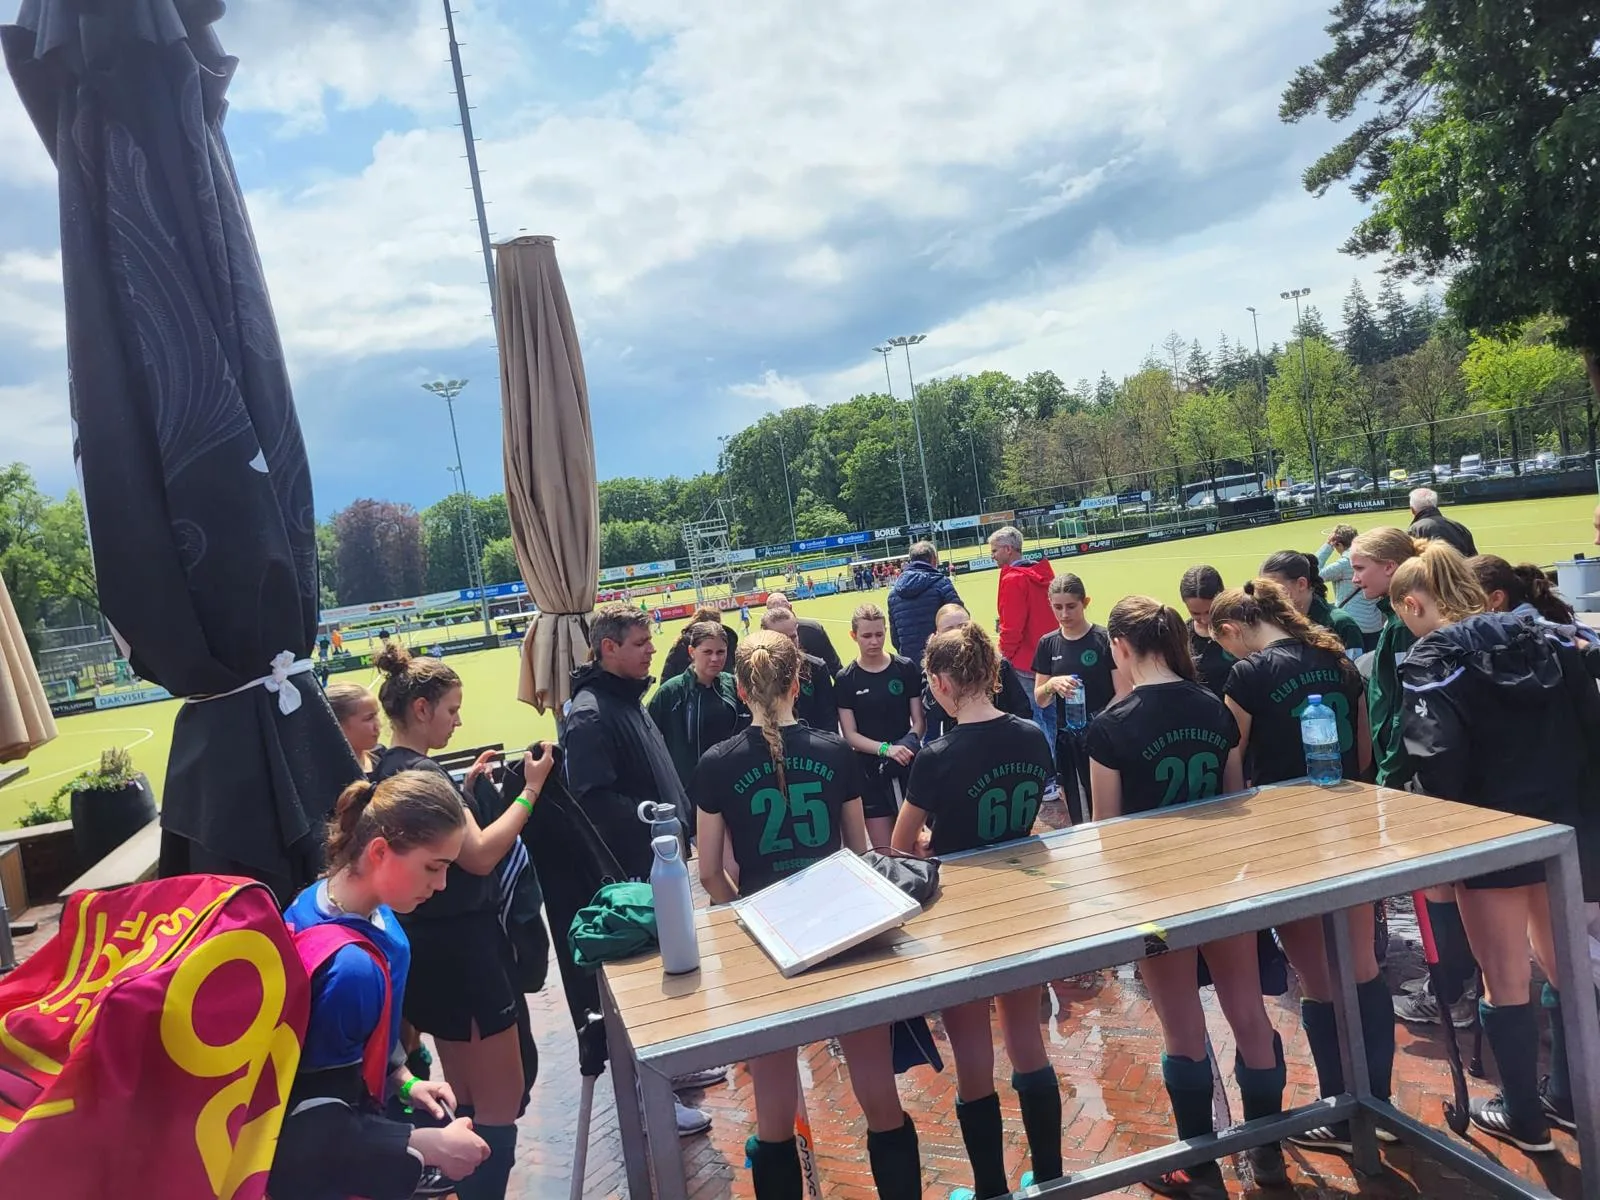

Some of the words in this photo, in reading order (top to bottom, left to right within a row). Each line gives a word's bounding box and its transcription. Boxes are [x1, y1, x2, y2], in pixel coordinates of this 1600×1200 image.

[1338, 502, 1353, 510] CLUB
[1353, 499, 1385, 508] PELLIKAAN
[874, 527, 901, 538] BOREK
[1088, 540, 1110, 548] PURE
[100, 692, 146, 705] DAKVISIE
[1270, 678, 1299, 703] CLUB
[1142, 736, 1166, 760] CLUB
[1166, 728, 1228, 750] RAFFELBERG
[734, 767, 761, 794] CLUB
[763, 757, 835, 782] RAFELBERG
[968, 773, 991, 798] CLUB
[1155, 752, 1219, 806] 26
[750, 781, 831, 856] 25
[978, 781, 1039, 840] 66
